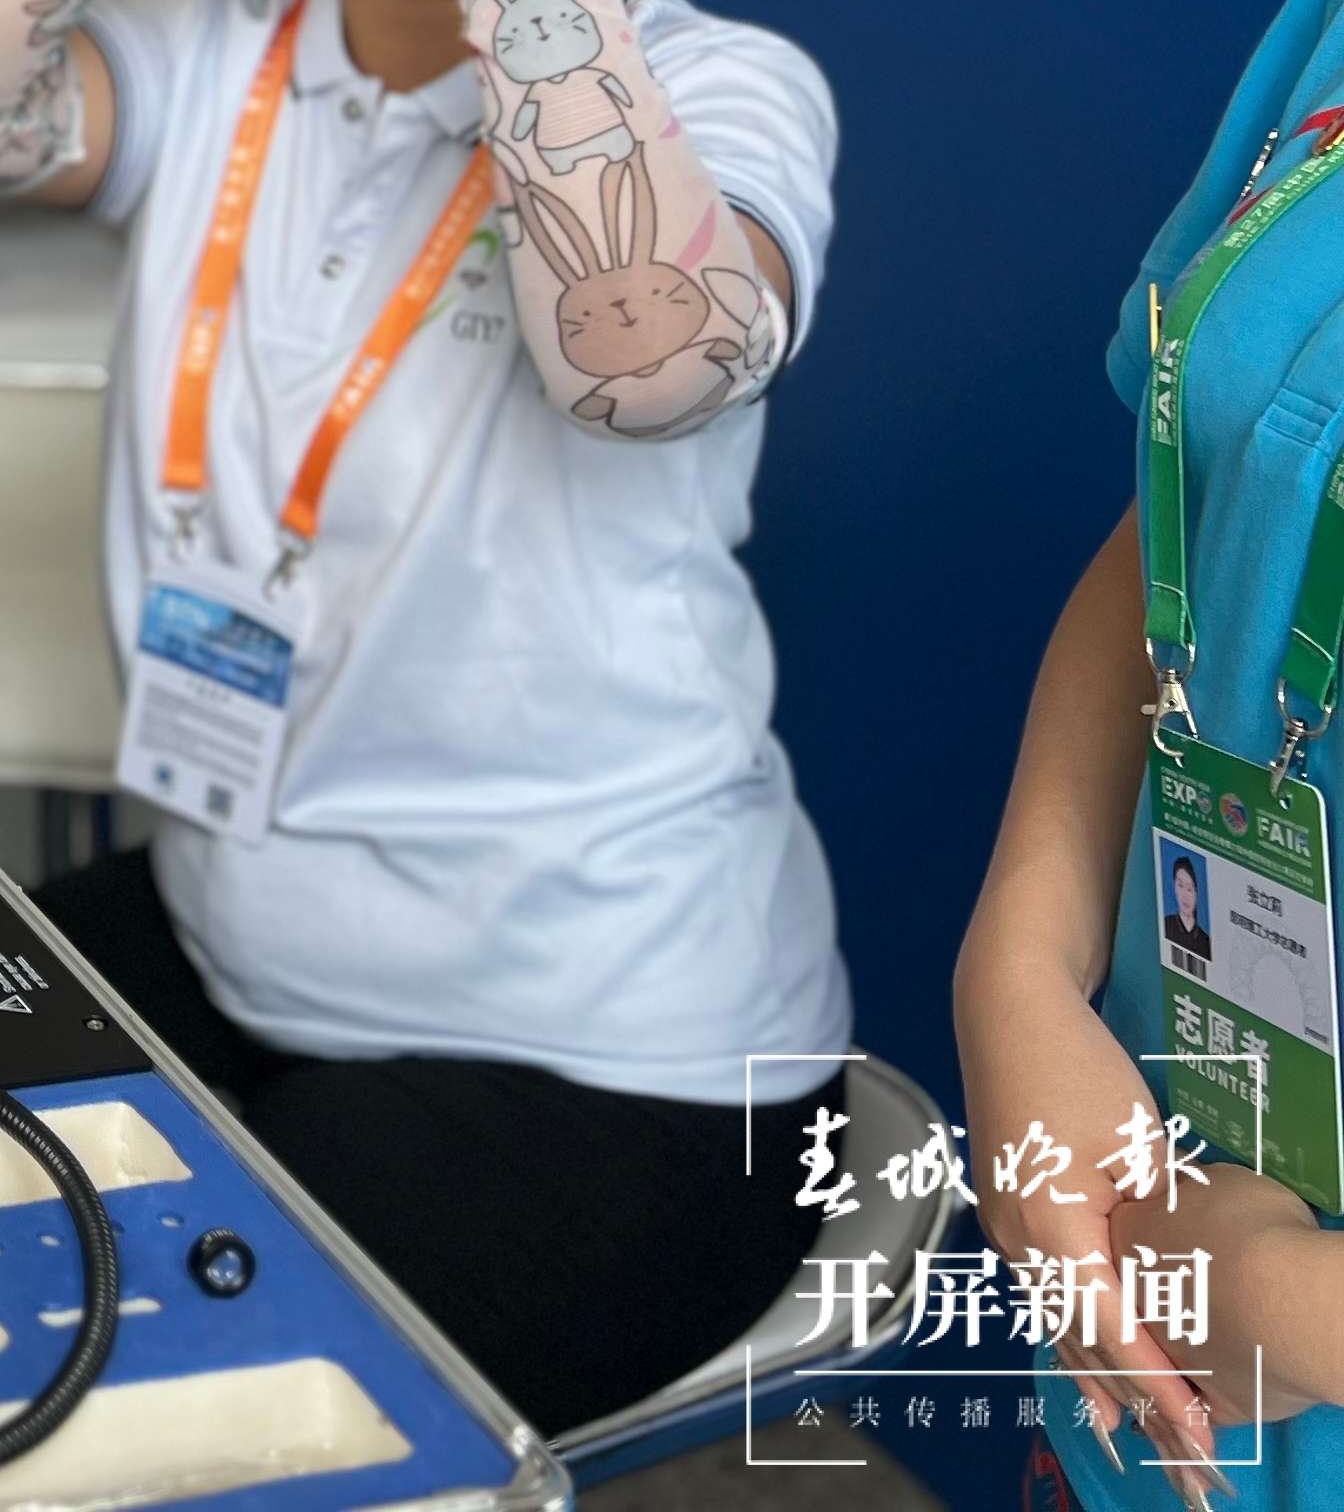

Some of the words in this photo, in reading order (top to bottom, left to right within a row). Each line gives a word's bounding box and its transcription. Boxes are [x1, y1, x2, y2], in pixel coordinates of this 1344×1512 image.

[1156, 339, 1179, 445] FAIR
[1256, 815, 1311, 857] FAIR
[1173, 994, 1271, 1086] 志愿者
[1176, 1044, 1270, 1114] VOLUNTEER
